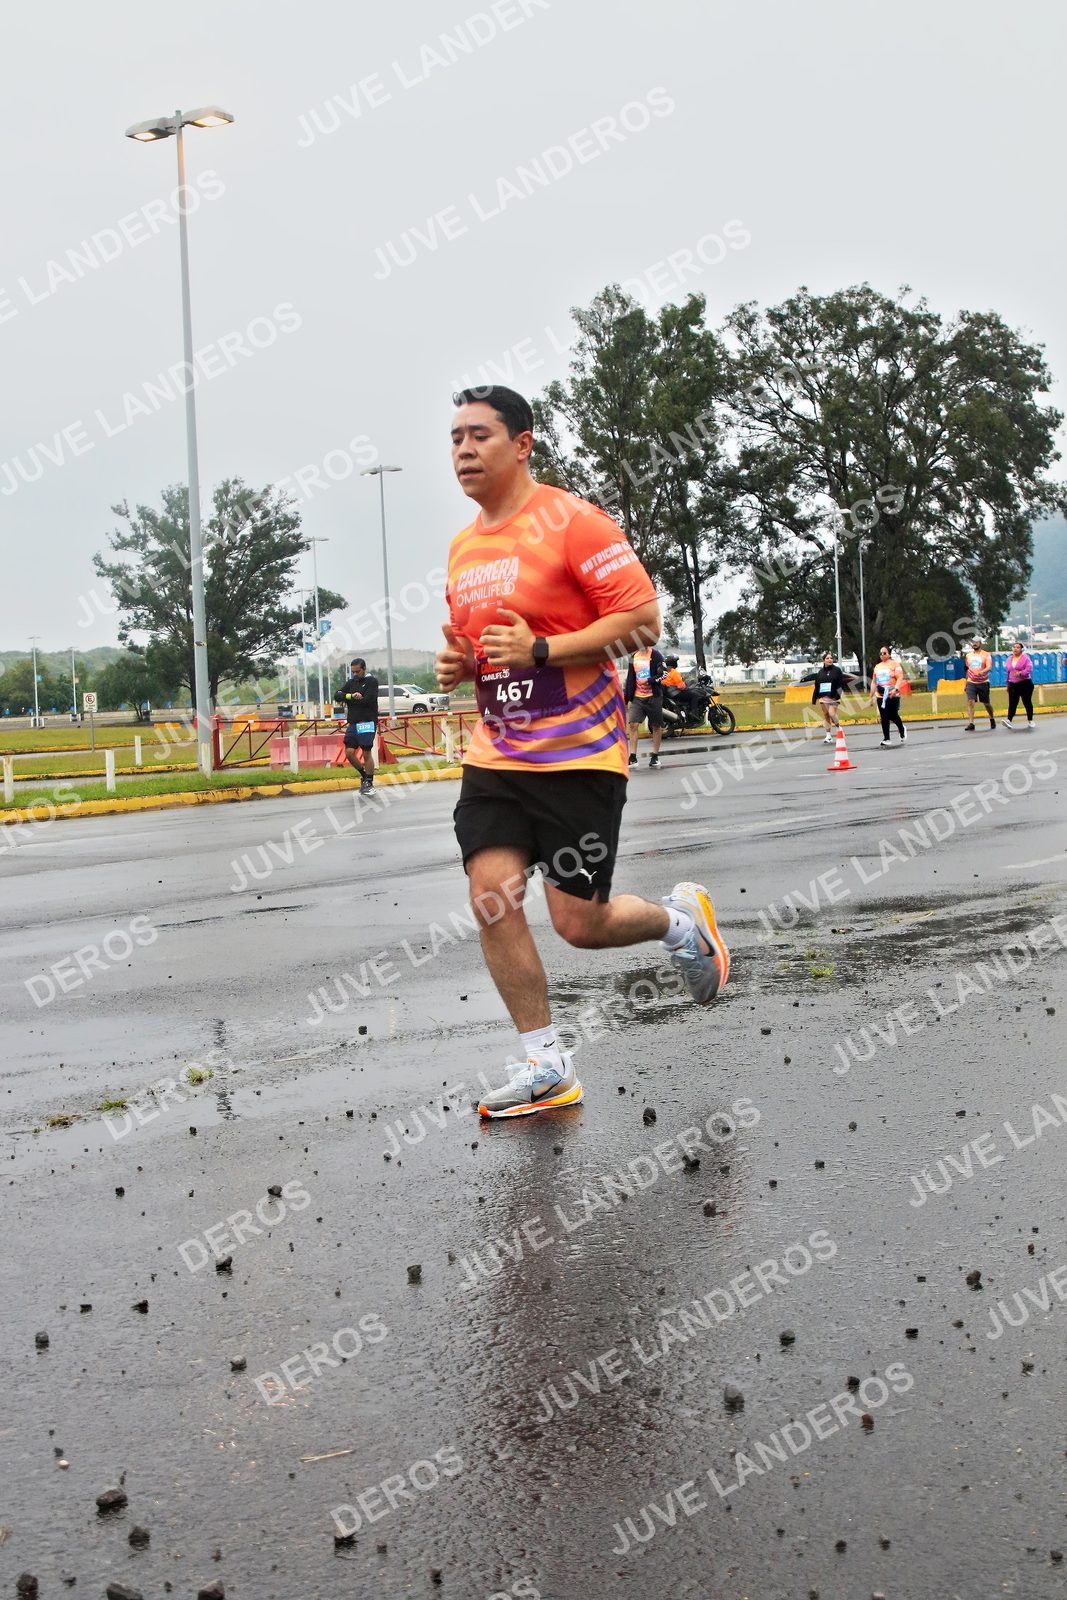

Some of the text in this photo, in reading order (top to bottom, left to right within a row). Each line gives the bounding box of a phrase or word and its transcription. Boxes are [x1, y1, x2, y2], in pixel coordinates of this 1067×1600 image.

[457, 556, 519, 592] CARRERA
[456, 583, 501, 607] OMNILIFE
[496, 679, 533, 703] 467
